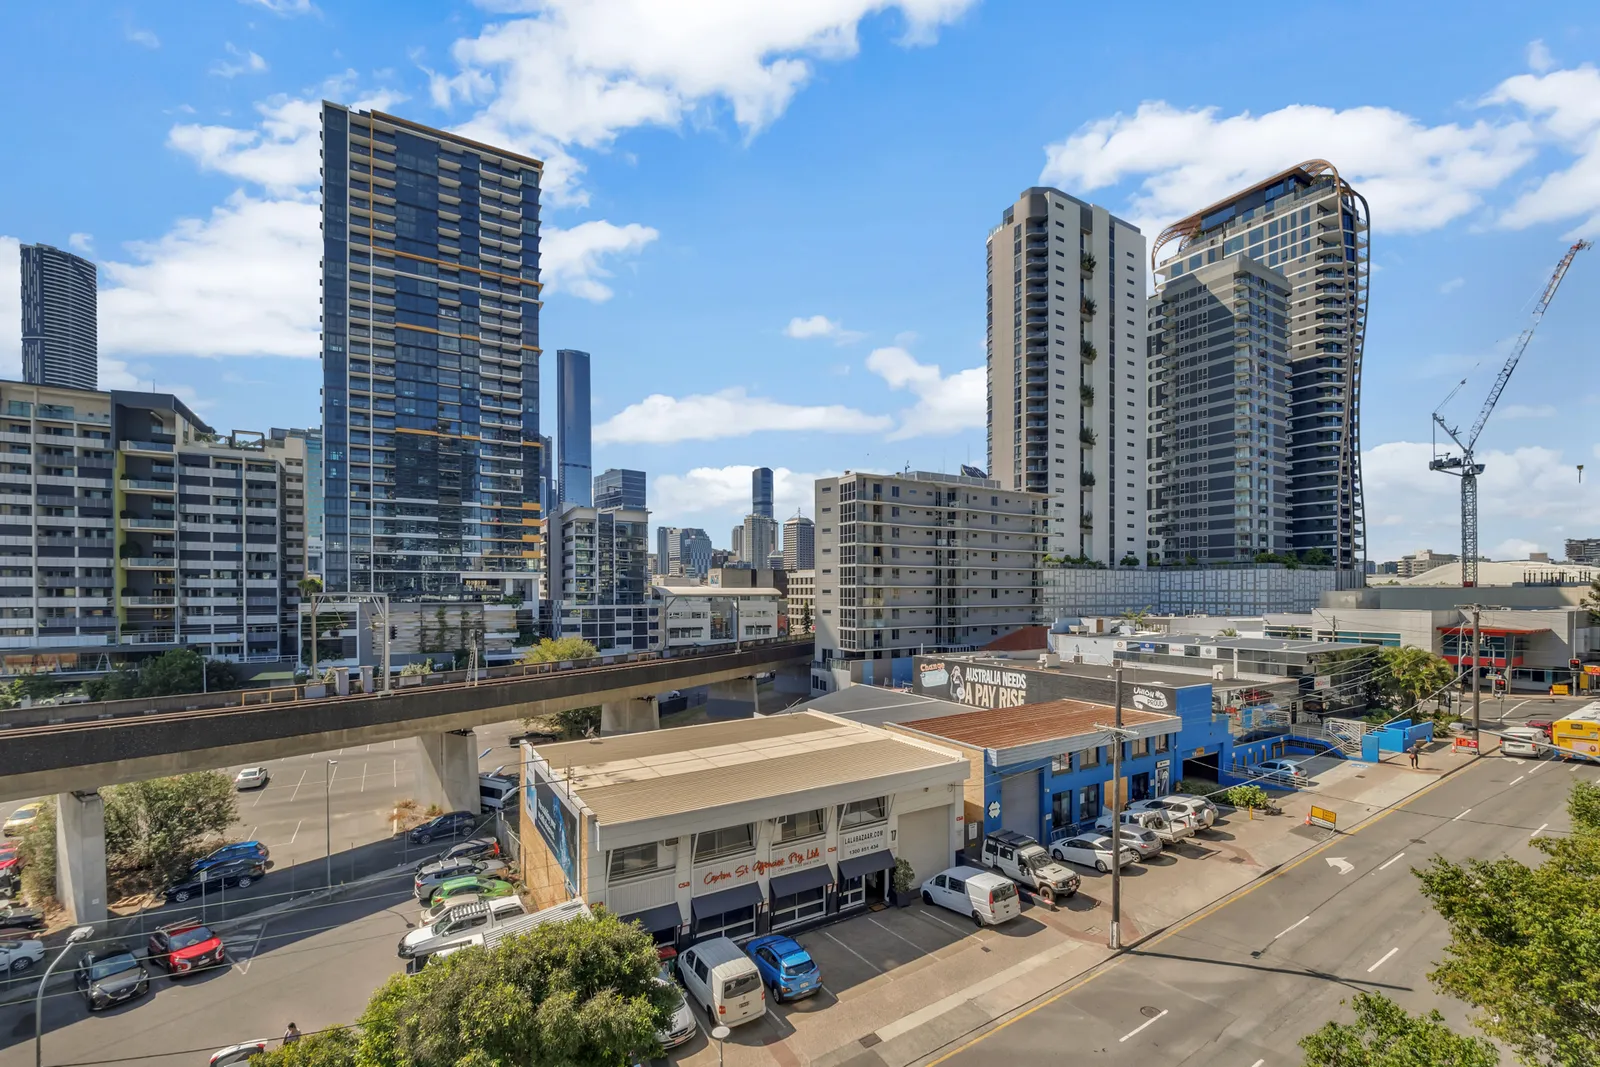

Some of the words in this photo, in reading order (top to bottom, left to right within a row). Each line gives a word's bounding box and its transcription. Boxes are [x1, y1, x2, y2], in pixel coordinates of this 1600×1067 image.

[965, 667, 1001, 685] AUSTRALIA
[1002, 671, 1026, 689] NEEDS
[964, 682, 973, 704] A
[975, 684, 997, 708] PAY
[998, 687, 1026, 709] RISE
[1133, 686, 1155, 698] UNION
[1147, 699, 1165, 707] PROUD
[844, 830, 883, 845] LALABAZAAR.COM
[891, 830, 896, 841] 17
[735, 865, 749, 877] St
[788, 851, 804, 865] Pty
[806, 847, 820, 860] Ltd
